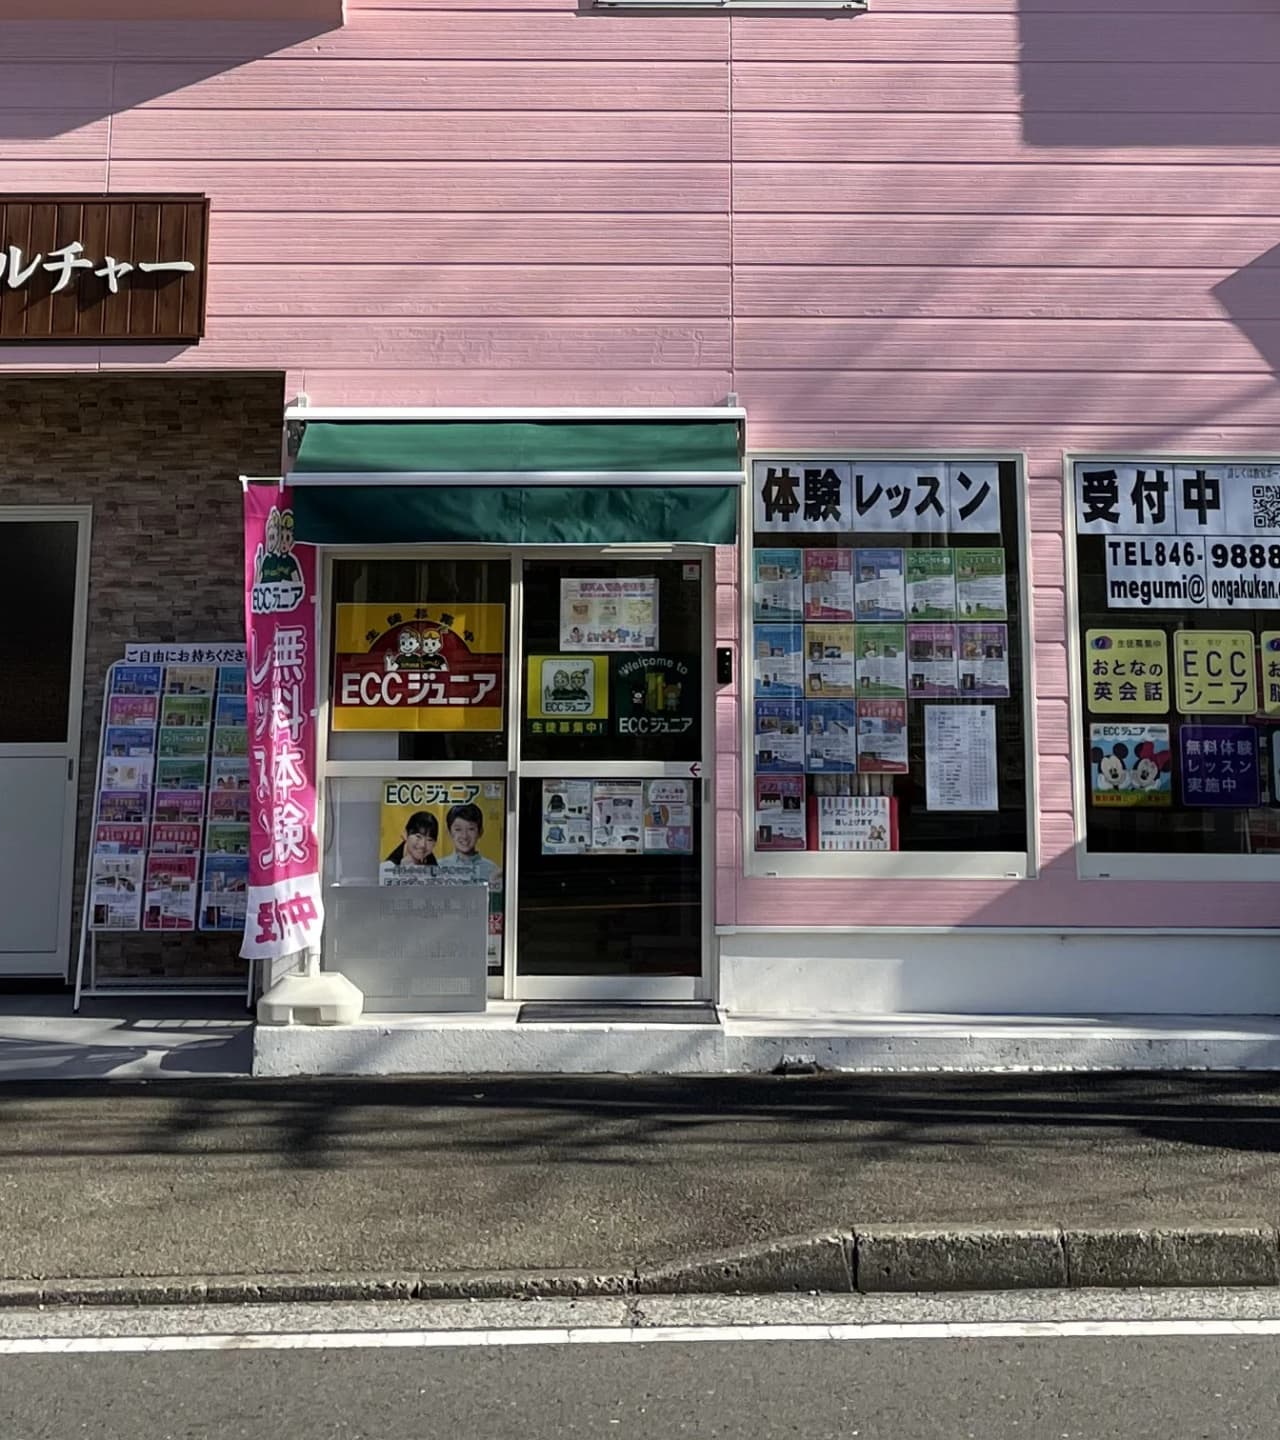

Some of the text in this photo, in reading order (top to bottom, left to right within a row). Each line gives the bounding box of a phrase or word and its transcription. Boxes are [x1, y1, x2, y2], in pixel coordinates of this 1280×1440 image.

[761, 467, 991, 522] 体験レッスン
[1081, 468, 1221, 525] 受付中
[126, 648, 248, 663] ご自由にお持ちくださ
[1183, 650, 1246, 678] ECC
[619, 657, 688, 675] Welcome to
[1092, 659, 1163, 677] おとなの
[341, 671, 497, 706] ECCジュニア
[1093, 681, 1163, 702] 英会話
[1183, 682, 1248, 705] シニア
[544, 702, 591, 712] ECCジュニア
[619, 717, 693, 733] ECCジュニア
[1102, 726, 1147, 737] ECCジュニア
[1186, 739, 1253, 757] 無料体験
[1187, 760, 1252, 772] レッスン
[386, 784, 480, 804] ECCジュニア
[1187, 777, 1237, 793] 実施中
